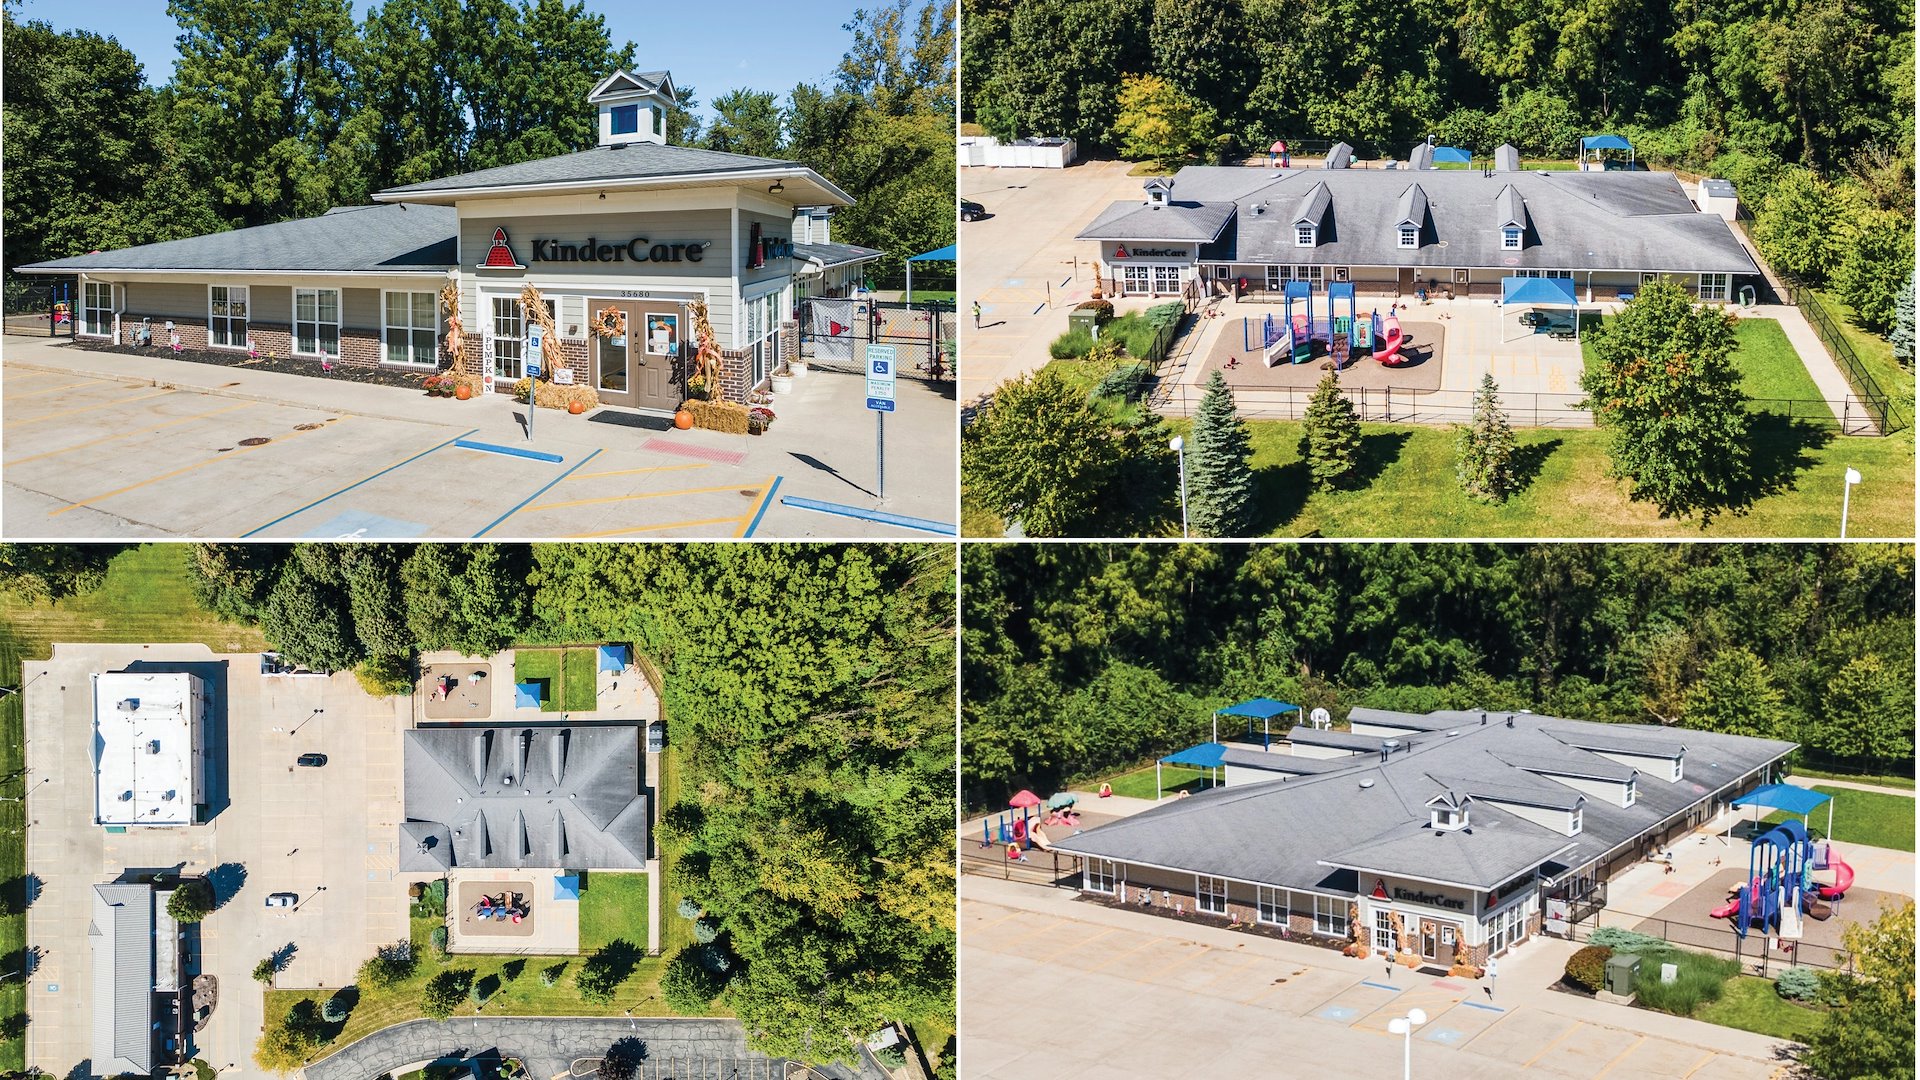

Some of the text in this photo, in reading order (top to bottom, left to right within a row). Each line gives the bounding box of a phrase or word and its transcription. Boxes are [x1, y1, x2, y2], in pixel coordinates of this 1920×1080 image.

[531, 237, 703, 262] KinderCare
[1132, 248, 1187, 257] KinderCare
[620, 290, 650, 298] 35680
[1394, 887, 1465, 910] KinderCare
